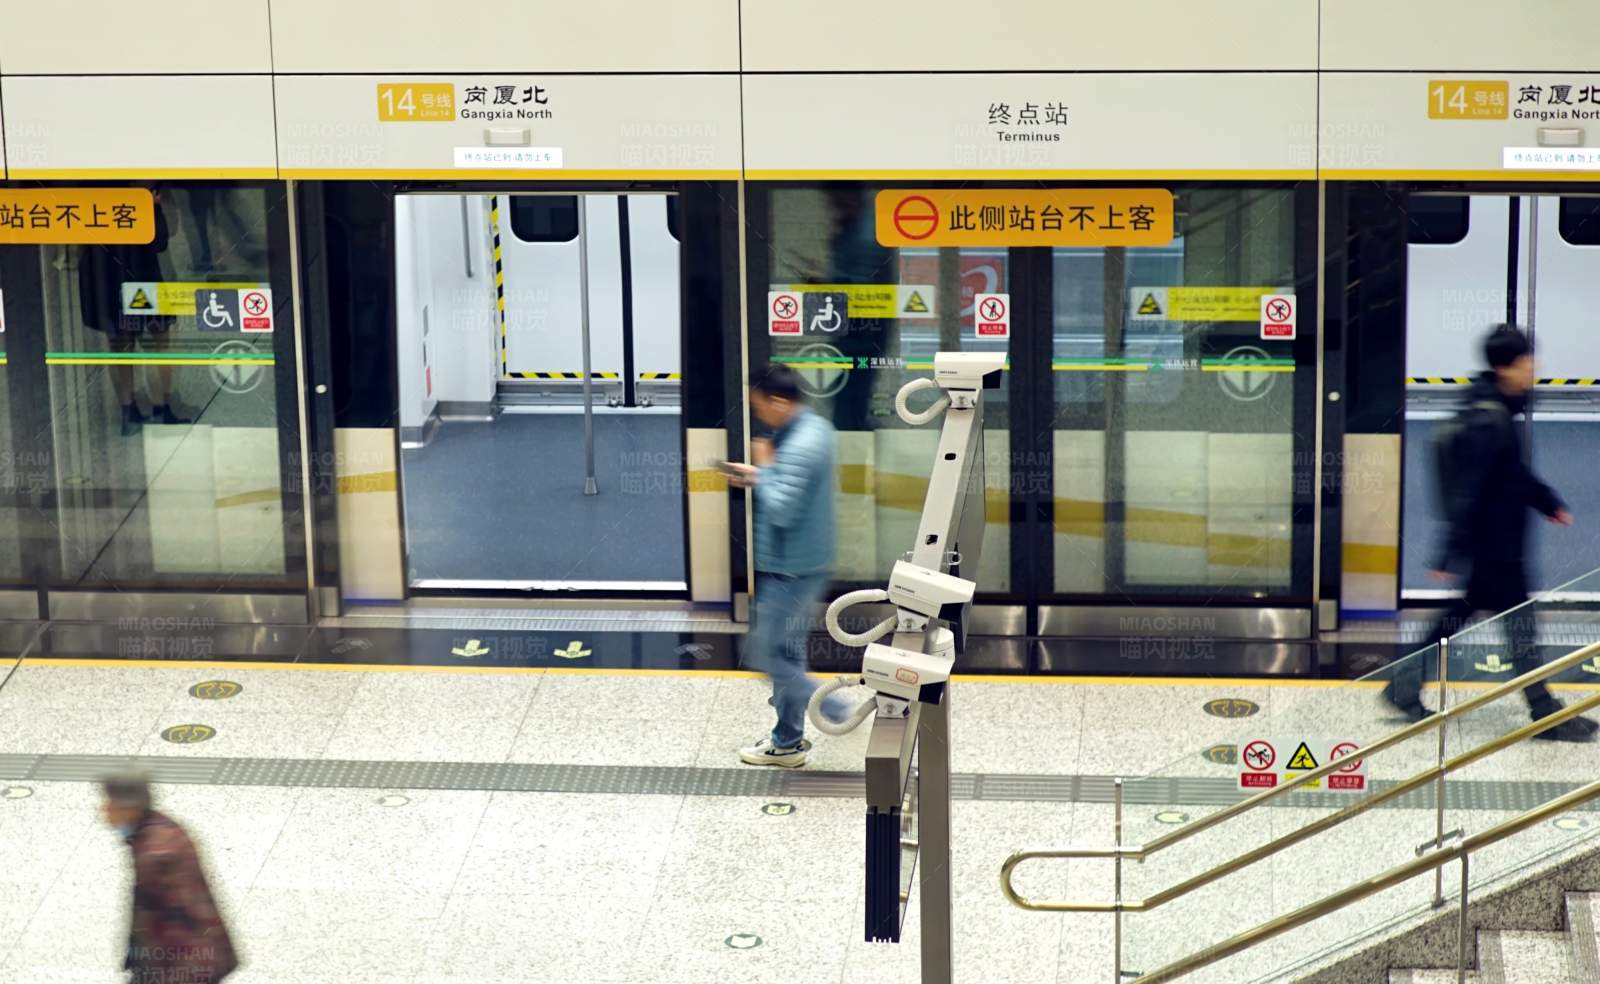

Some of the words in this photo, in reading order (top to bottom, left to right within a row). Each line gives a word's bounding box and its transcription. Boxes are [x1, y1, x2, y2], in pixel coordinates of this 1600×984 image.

[381, 87, 416, 116] 14
[420, 92, 452, 108] 号线
[464, 83, 549, 104] 岗厦北
[1432, 84, 1468, 114] 14
[1472, 91, 1505, 107] 号线
[1517, 84, 1600, 106] 岗厦北
[460, 106, 513, 119] Gangxia
[516, 106, 553, 118] North
[988, 101, 1069, 126] 终点站
[1513, 108, 1568, 122] Gangxia
[997, 131, 1061, 142] Terminus
[0, 203, 137, 229] 站台不上客
[949, 204, 1155, 231] 此侧站台不上客
